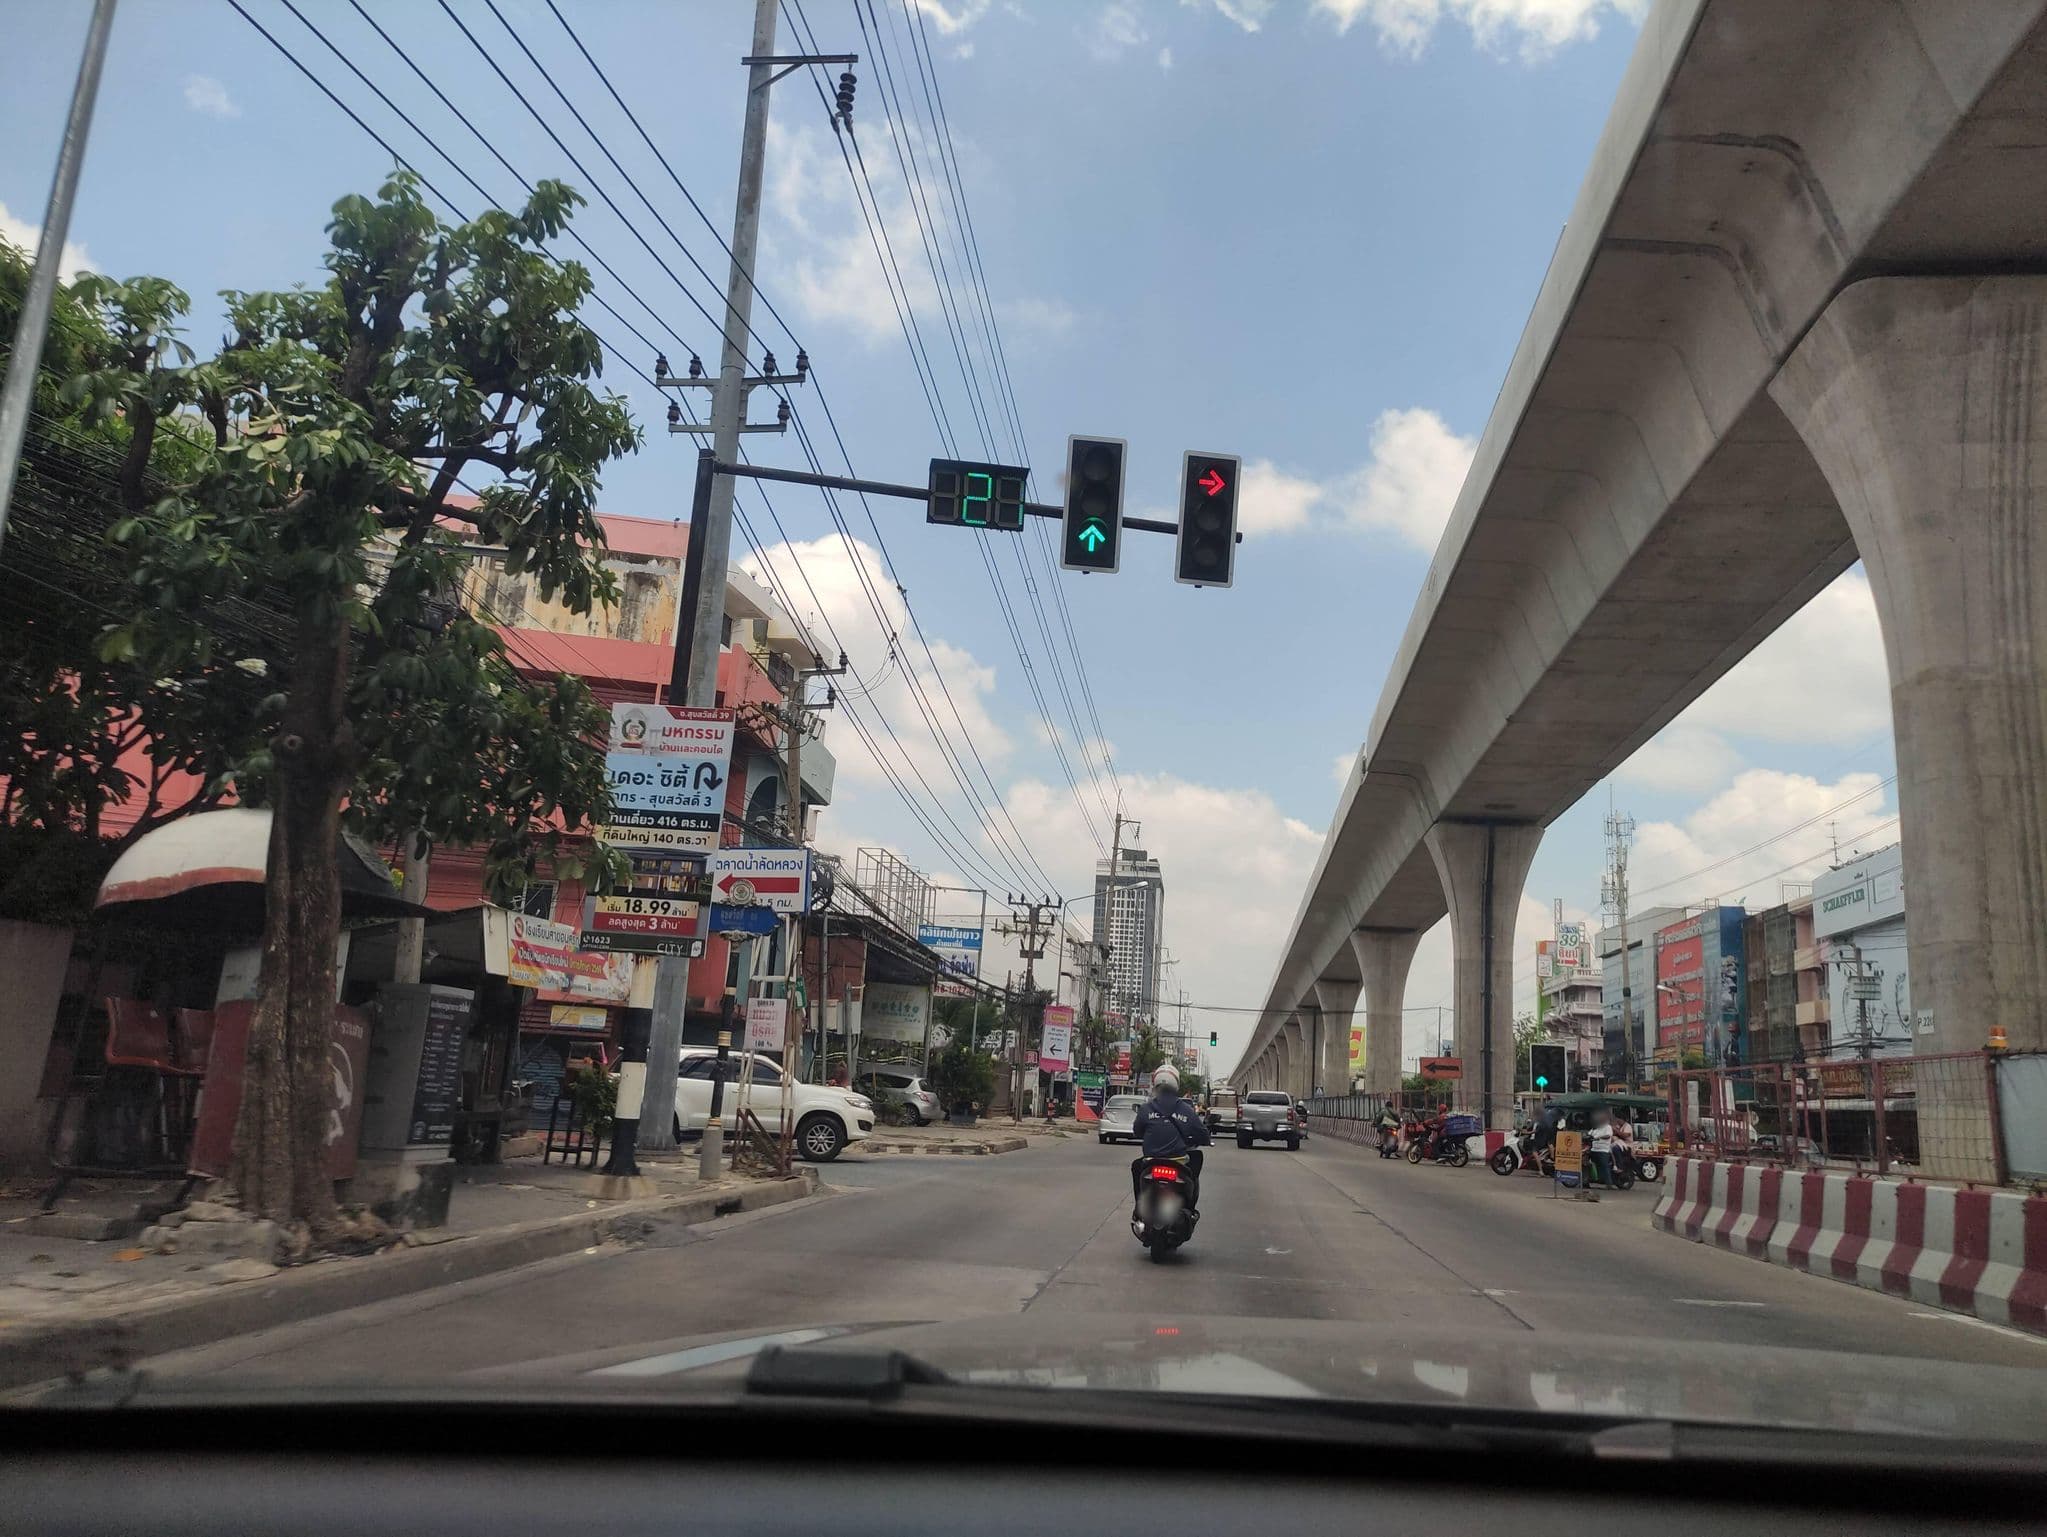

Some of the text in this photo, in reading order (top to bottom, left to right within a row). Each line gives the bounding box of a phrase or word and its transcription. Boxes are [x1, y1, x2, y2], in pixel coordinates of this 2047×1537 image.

[662, 726, 725, 740] มหกรรม
[659, 742, 724, 754] บ้านและคอนโด
[611, 764, 690, 788] เดอะ ซิตี้
[649, 791, 702, 808] สุขสวัสดิ์
[704, 797, 712, 807] 3
[657, 816, 678, 827] 416
[681, 818, 712, 829] ตร.ม.
[653, 833, 674, 844] 140
[715, 851, 803, 871] ตลาดน้ำลัดหลวง
[624, 898, 671, 915] 18.99
[777, 899, 793, 908] กม.
[608, 917, 646, 930] ลดสูงสุด
[649, 917, 658, 930] 3
[590, 936, 611, 945] 1623
[656, 943, 684, 956] CITY
